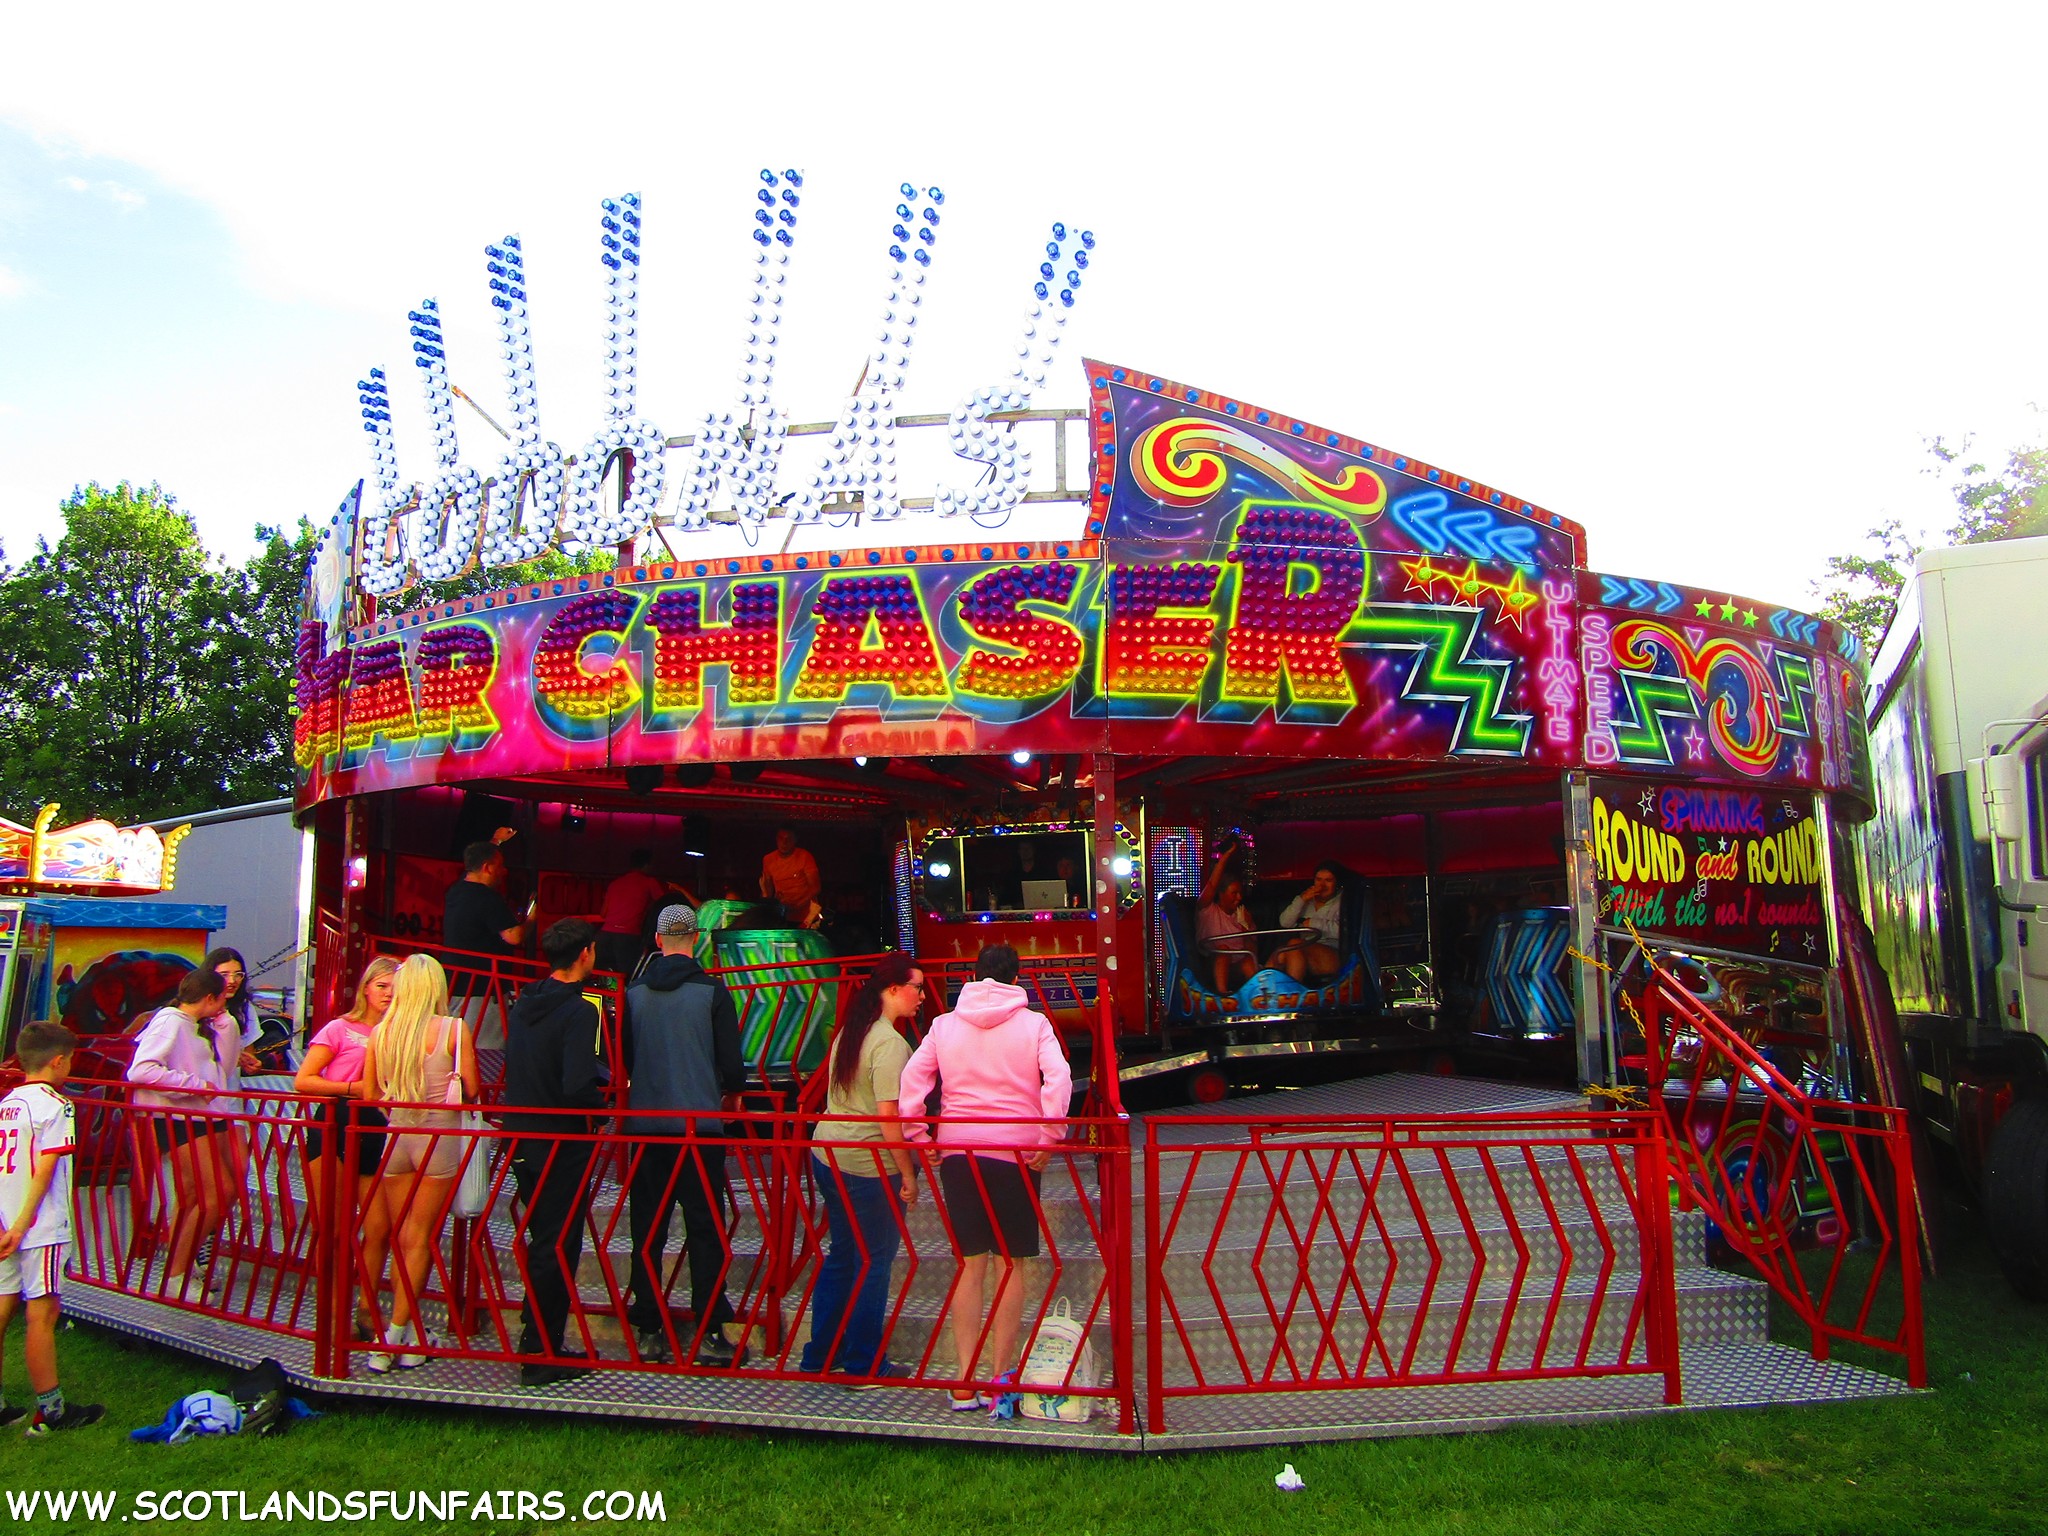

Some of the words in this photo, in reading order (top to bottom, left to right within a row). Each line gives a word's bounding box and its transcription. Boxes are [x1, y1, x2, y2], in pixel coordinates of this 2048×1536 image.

[535, 498, 1371, 722] CHASER
[1539, 580, 1578, 742] ULTIMATE
[1580, 614, 1618, 765] SPEED
[1813, 656, 1836, 787] PUMPIN
[1592, 796, 1685, 883] ROUND
[1696, 839, 1739, 881] and
[1747, 816, 1821, 885] ROUND
[1658, 787, 1766, 836] SPINNING
[1611, 884, 1667, 927] With
[1674, 887, 1707, 927] the
[1757, 893, 1822, 925] sounds
